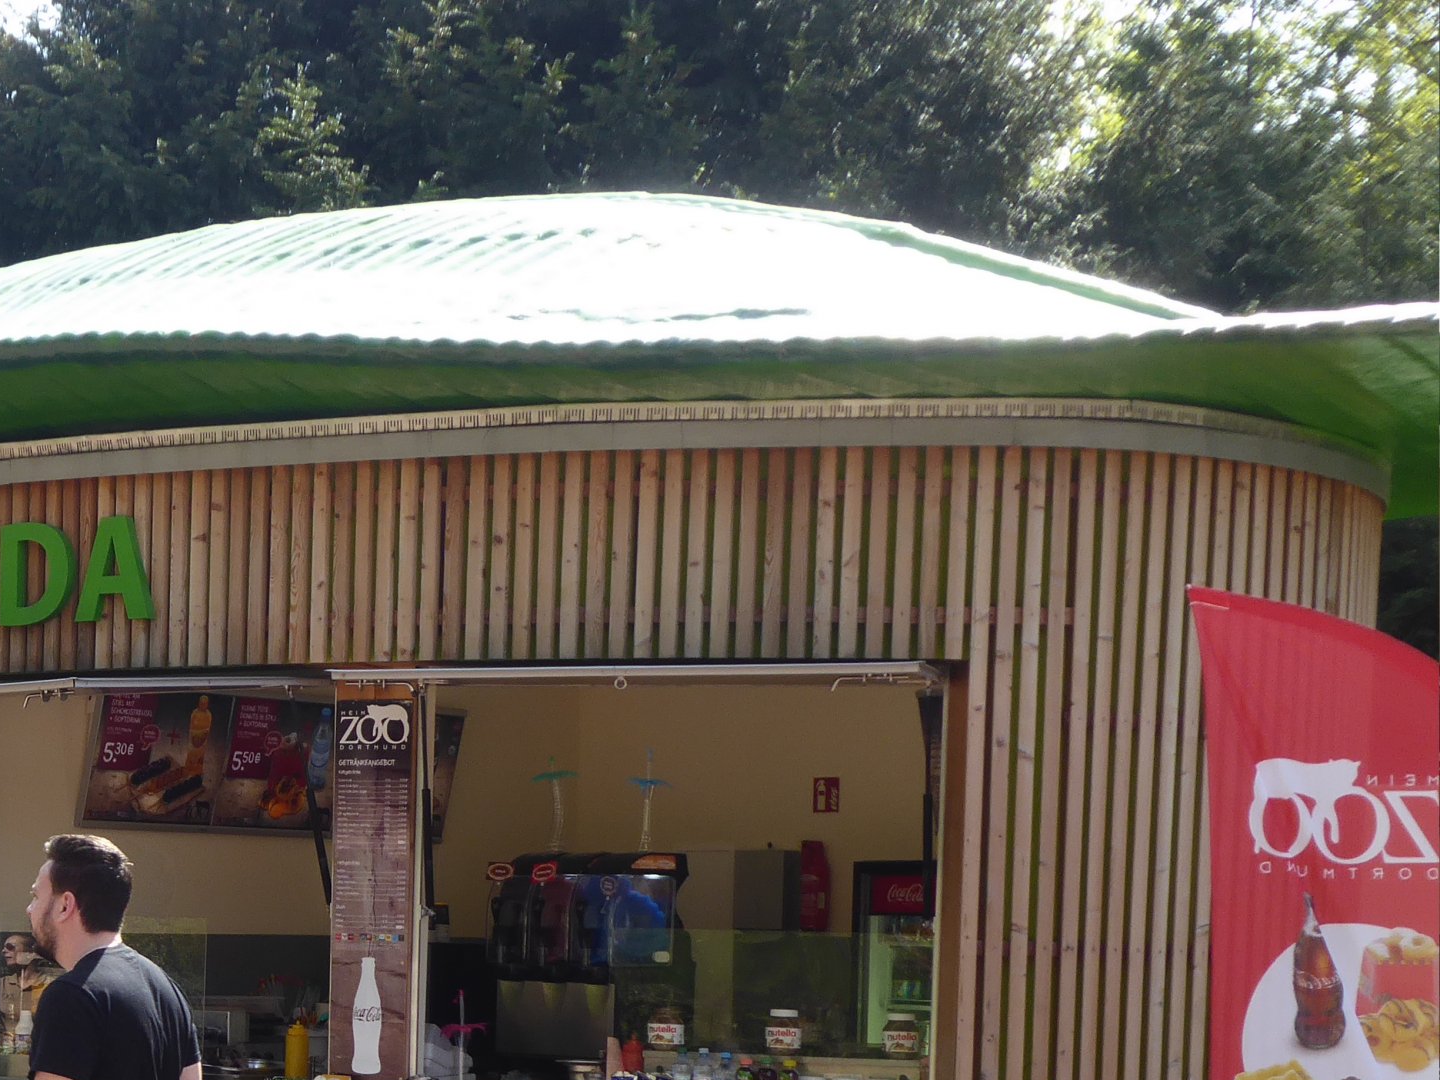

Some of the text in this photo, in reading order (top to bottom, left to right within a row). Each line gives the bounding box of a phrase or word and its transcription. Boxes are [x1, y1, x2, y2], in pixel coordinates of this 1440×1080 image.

[339, 715, 410, 745] ZOO
[648, 1025, 677, 1034] nutella
[767, 1028, 797, 1038] nutella
[887, 1033, 917, 1042] nutella
